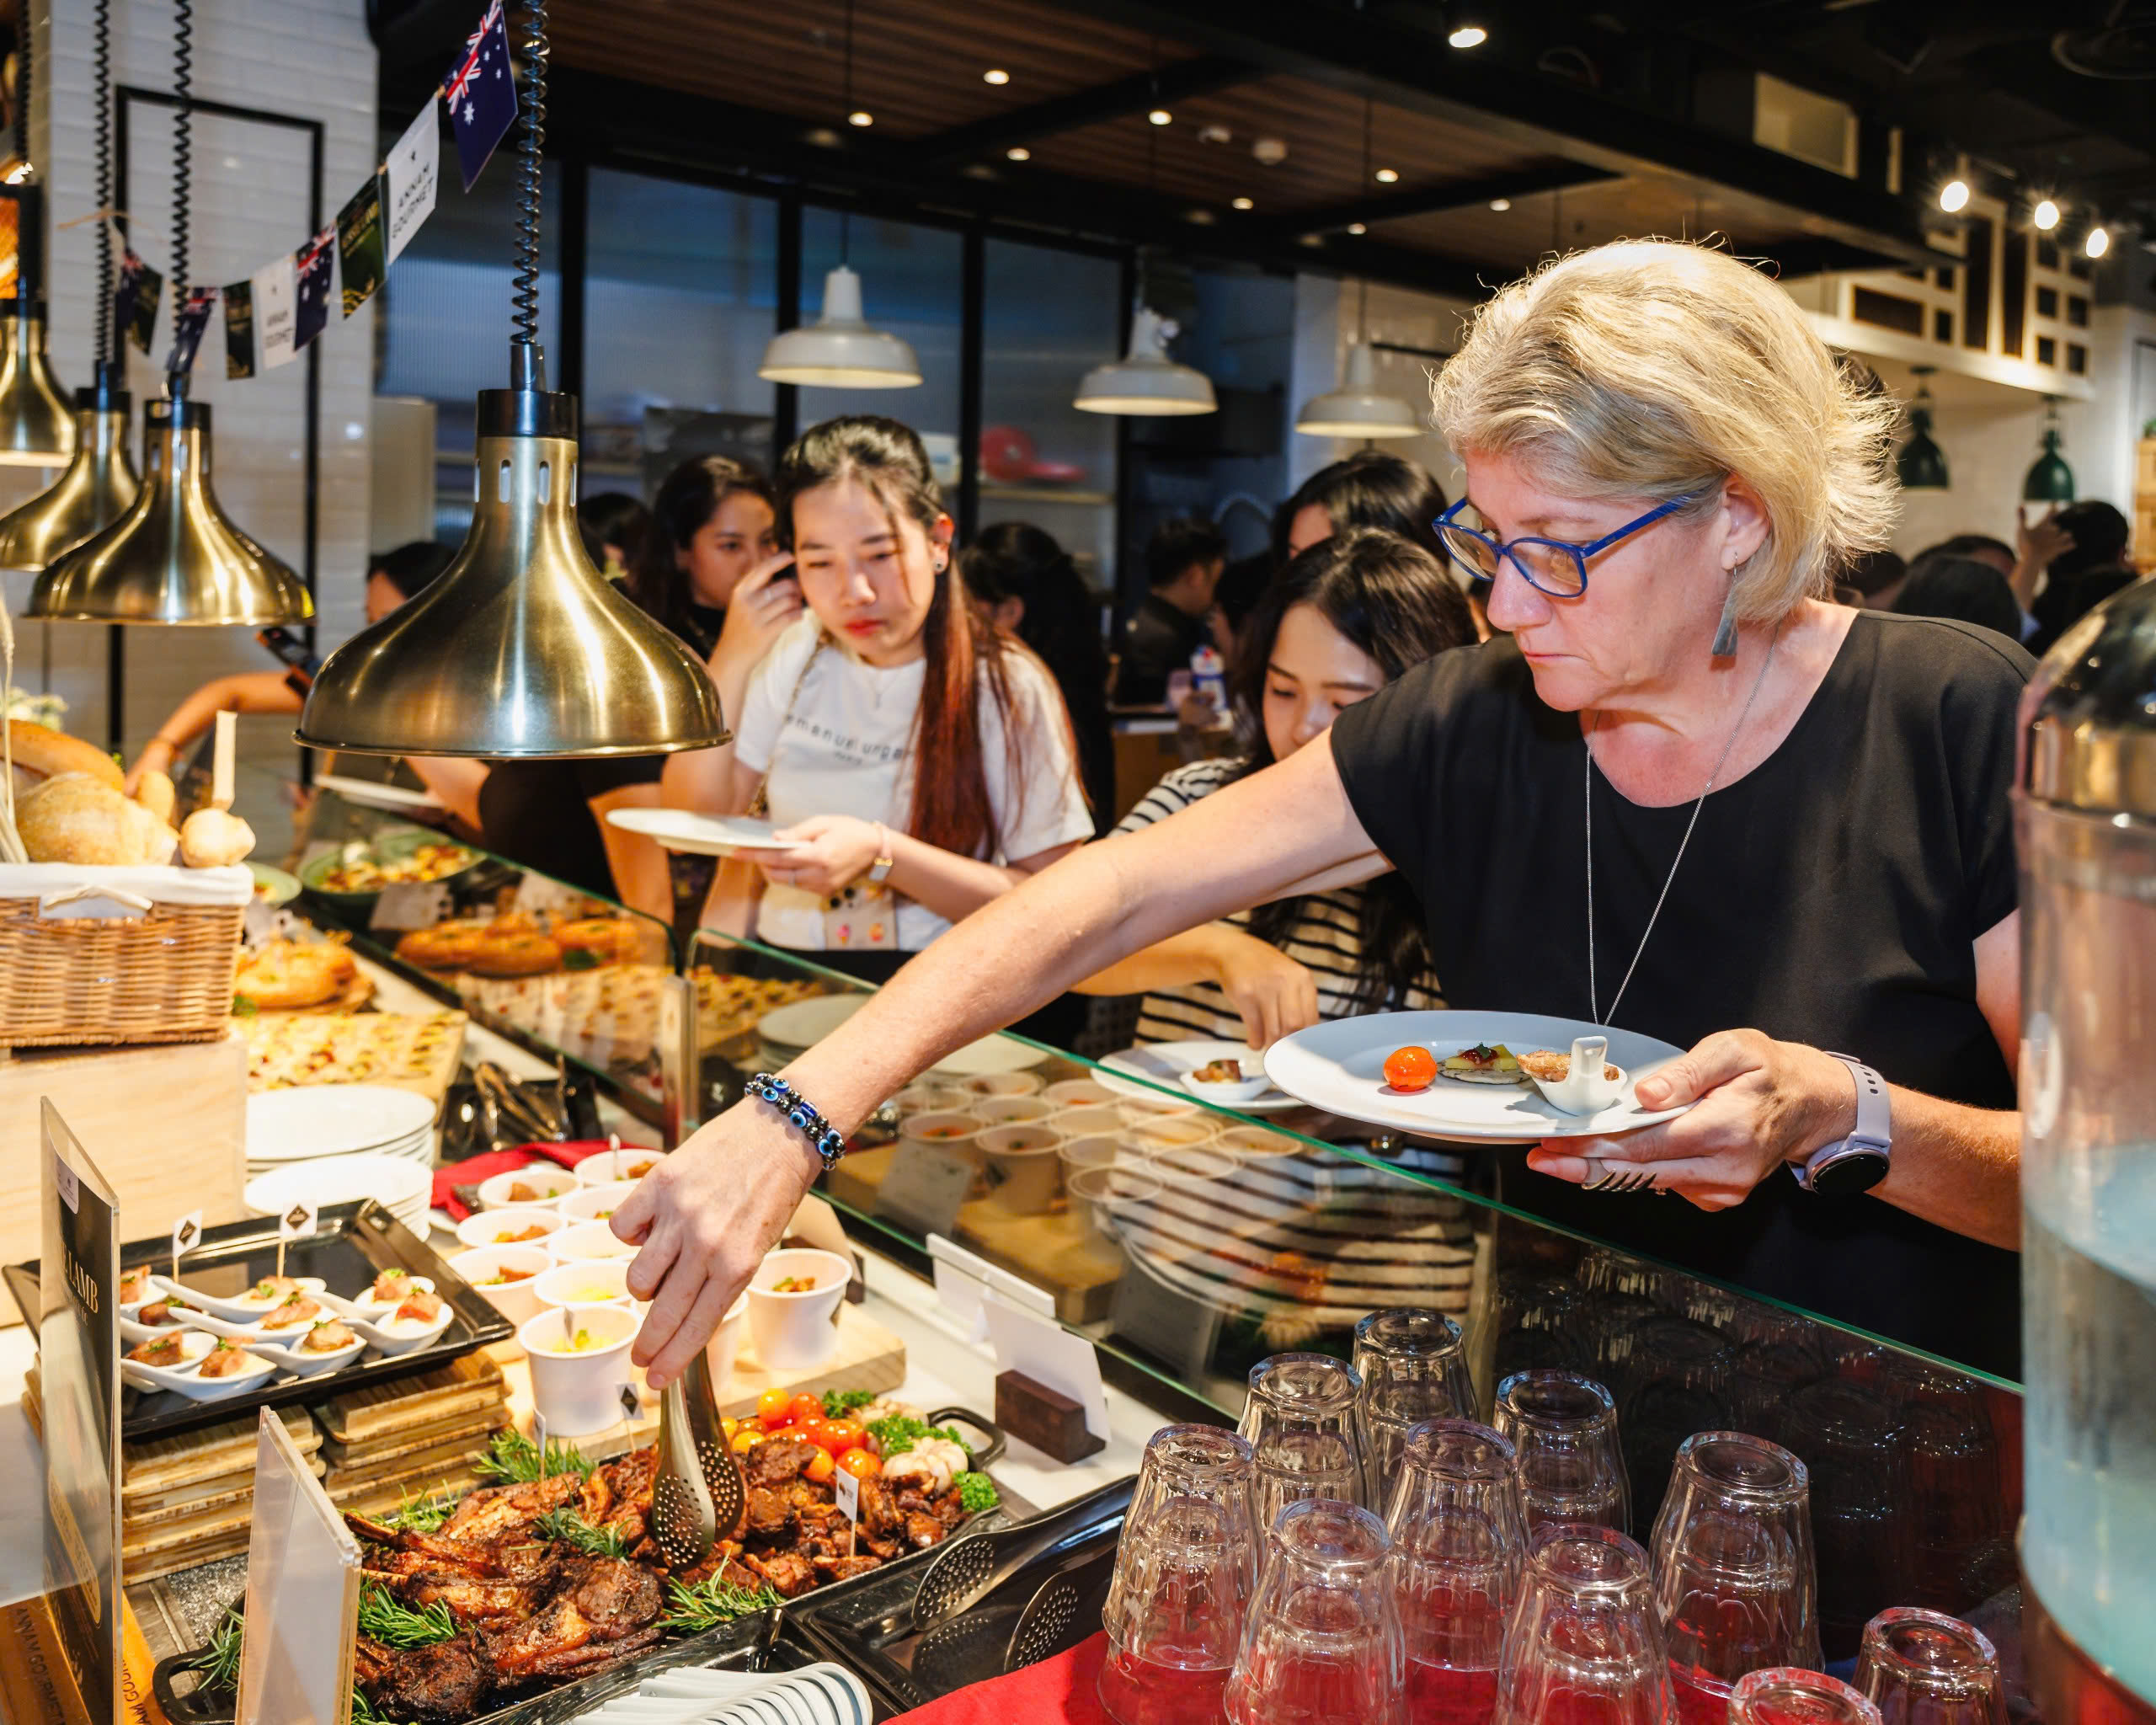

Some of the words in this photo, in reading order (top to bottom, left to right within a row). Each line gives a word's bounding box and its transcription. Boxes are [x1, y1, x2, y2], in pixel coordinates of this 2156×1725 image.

[68, 1249, 99, 1314] LAMB
[123, 1658, 141, 1702] GOU
[129, 1701, 152, 1725] AM
